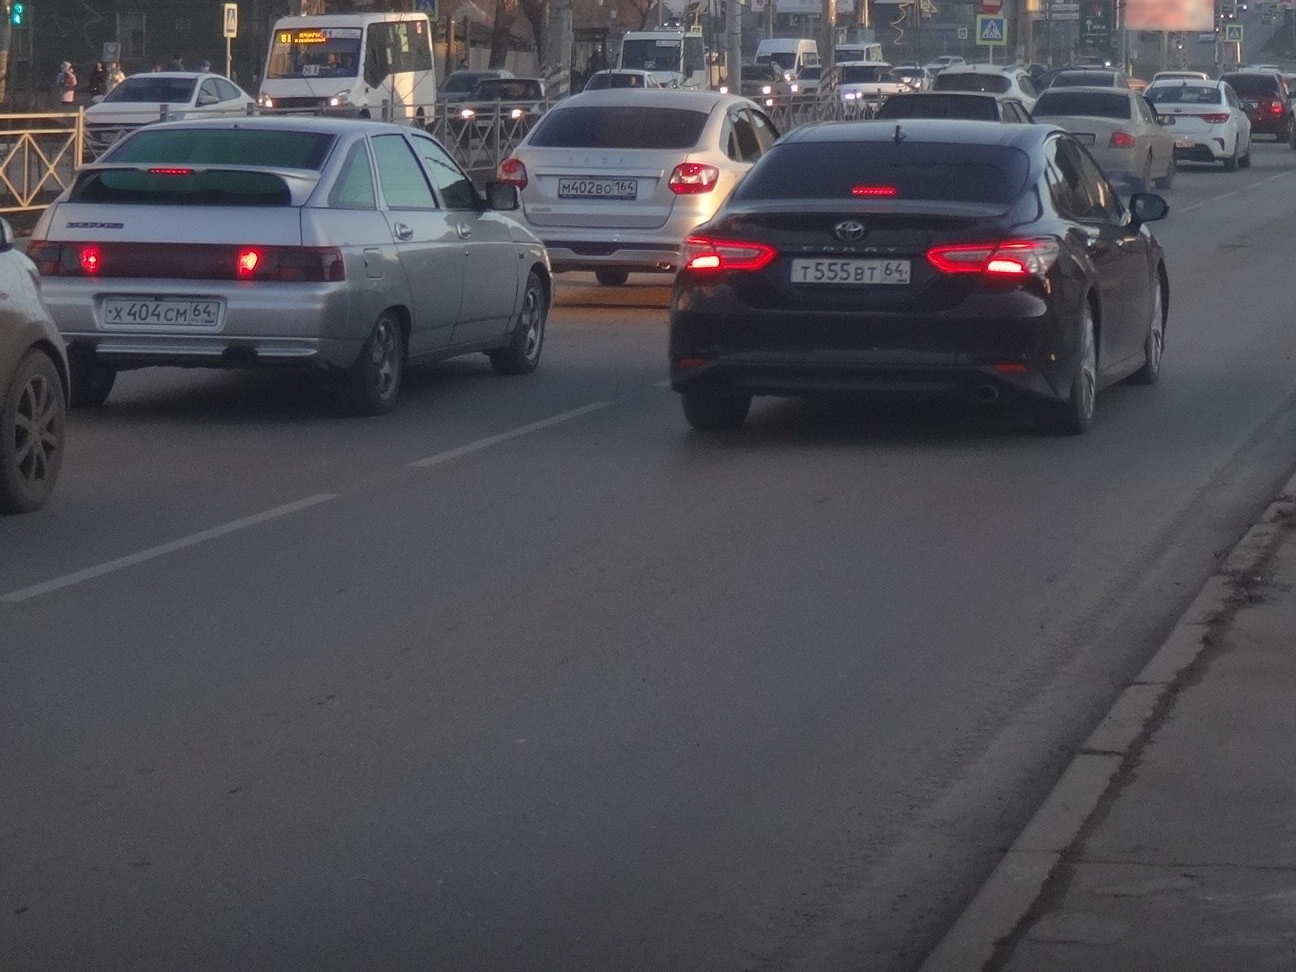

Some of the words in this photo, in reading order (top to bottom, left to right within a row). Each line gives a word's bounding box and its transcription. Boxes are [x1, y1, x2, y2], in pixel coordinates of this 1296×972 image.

[281, 34, 292, 43] 81
[562, 181, 612, 195] М402ВО
[615, 182, 634, 192] 164
[801, 262, 877, 281] Т555ВТ
[884, 262, 903, 277] 64
[113, 303, 187, 322] Х404СМ
[193, 304, 211, 318] 64
